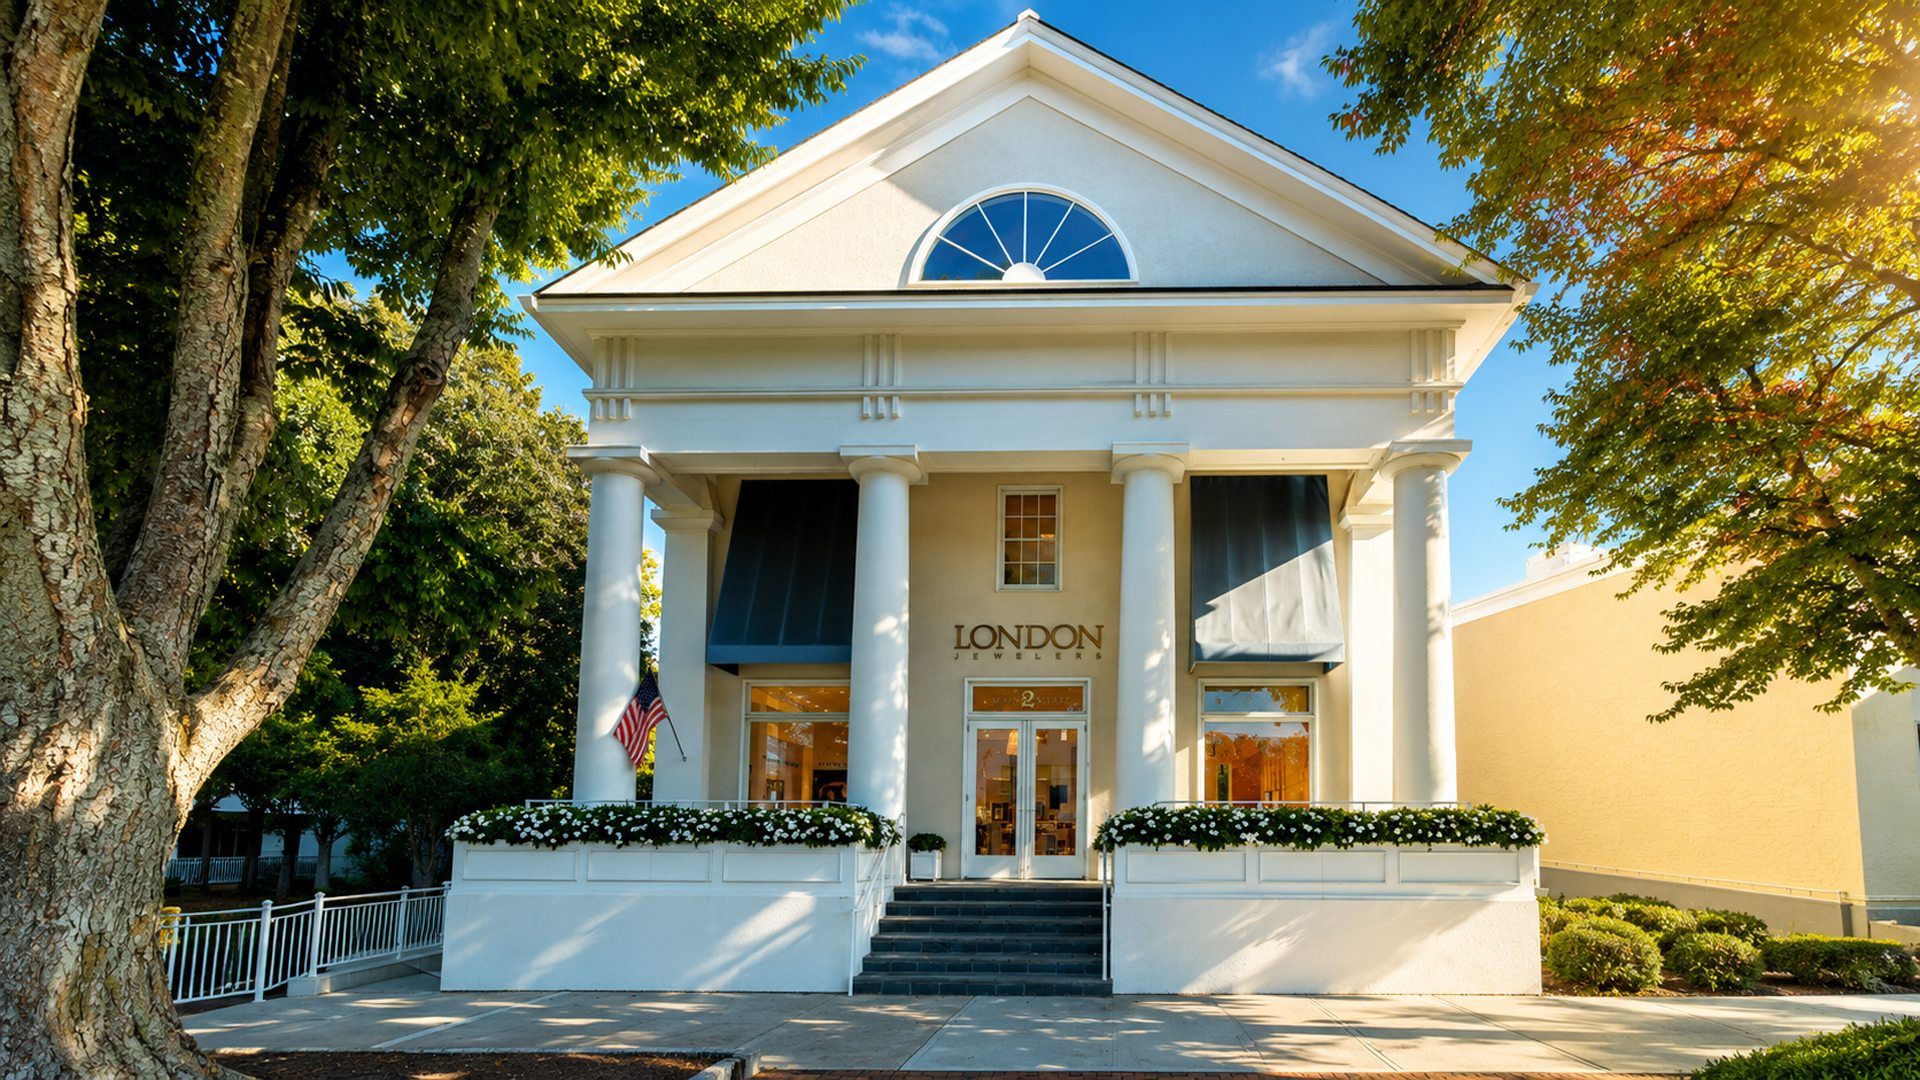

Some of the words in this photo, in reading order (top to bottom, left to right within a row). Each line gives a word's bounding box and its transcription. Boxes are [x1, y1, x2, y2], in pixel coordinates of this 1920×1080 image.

[954, 624, 1105, 650] LONDON
[954, 652, 1102, 661] JEWELERS
[1021, 690, 1036, 708] 2
